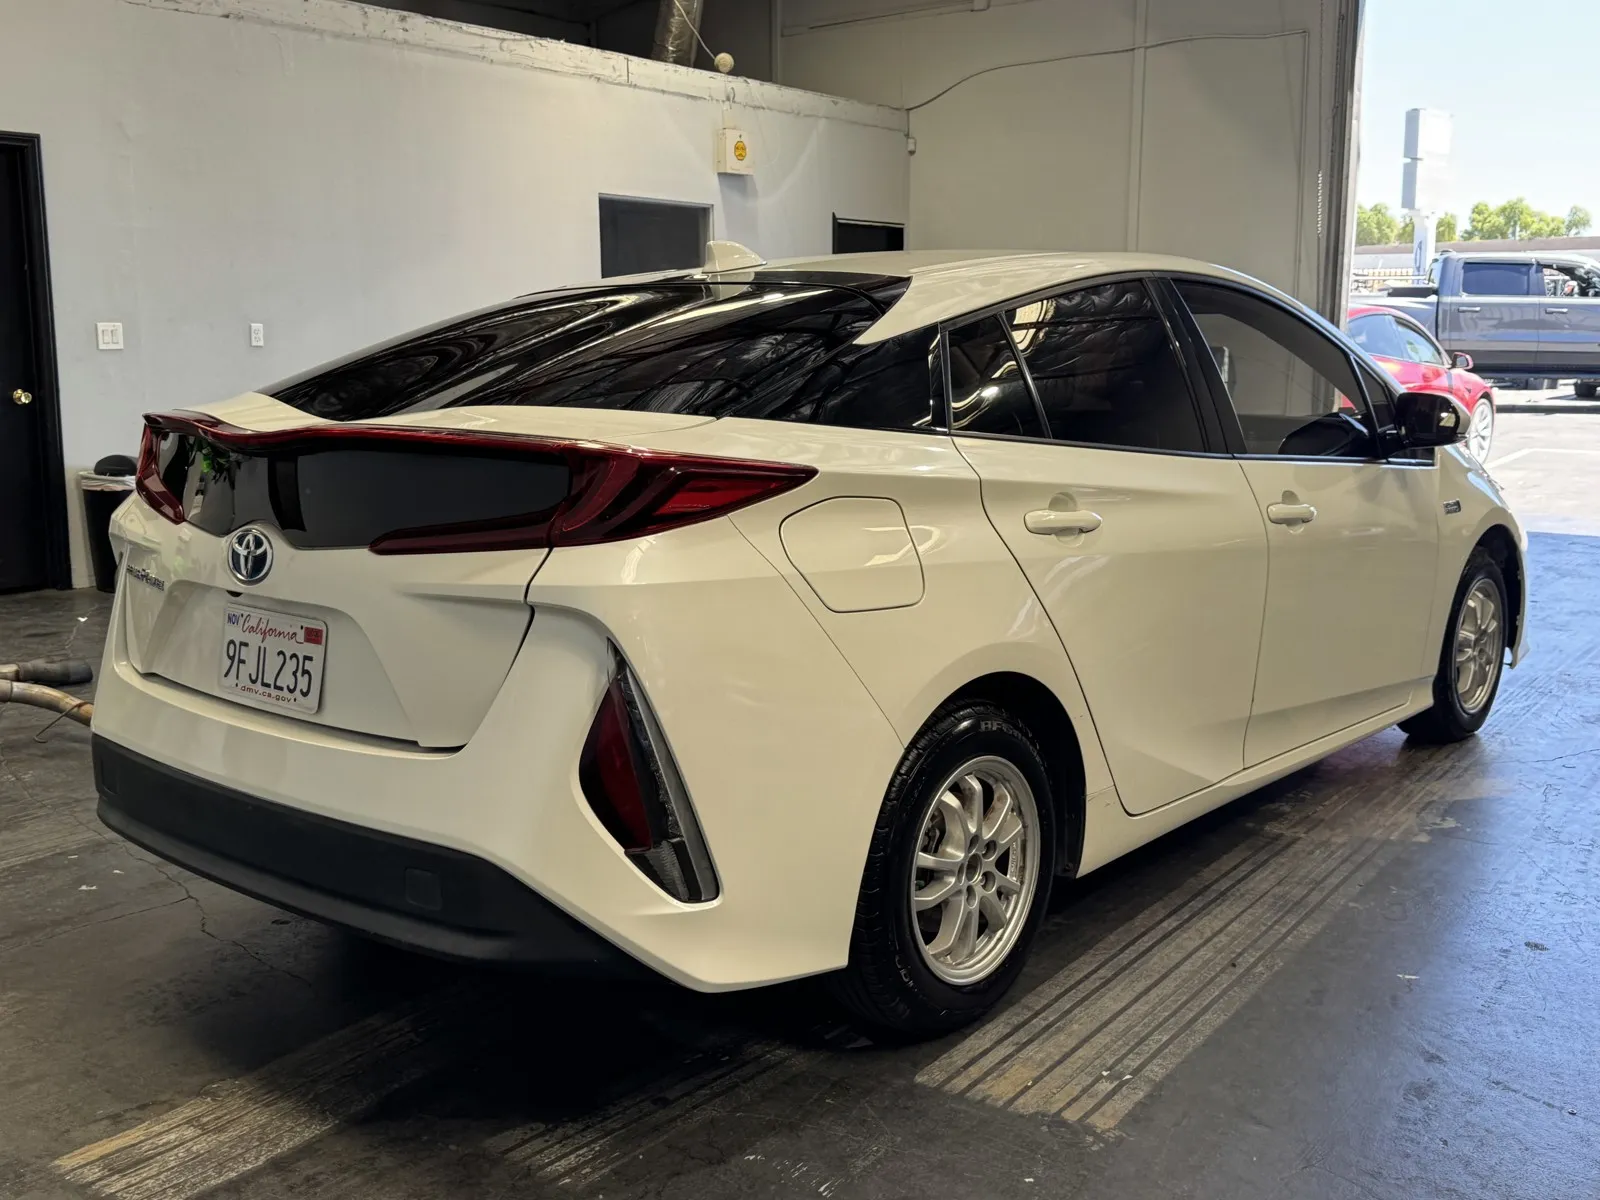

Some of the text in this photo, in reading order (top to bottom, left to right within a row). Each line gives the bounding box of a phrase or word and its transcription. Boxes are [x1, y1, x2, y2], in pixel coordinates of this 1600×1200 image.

[227, 613, 240, 625] NOV
[242, 614, 304, 644] California
[224, 639, 314, 698] 9FJL235
[240, 686, 292, 703] dmv.ca.gov
